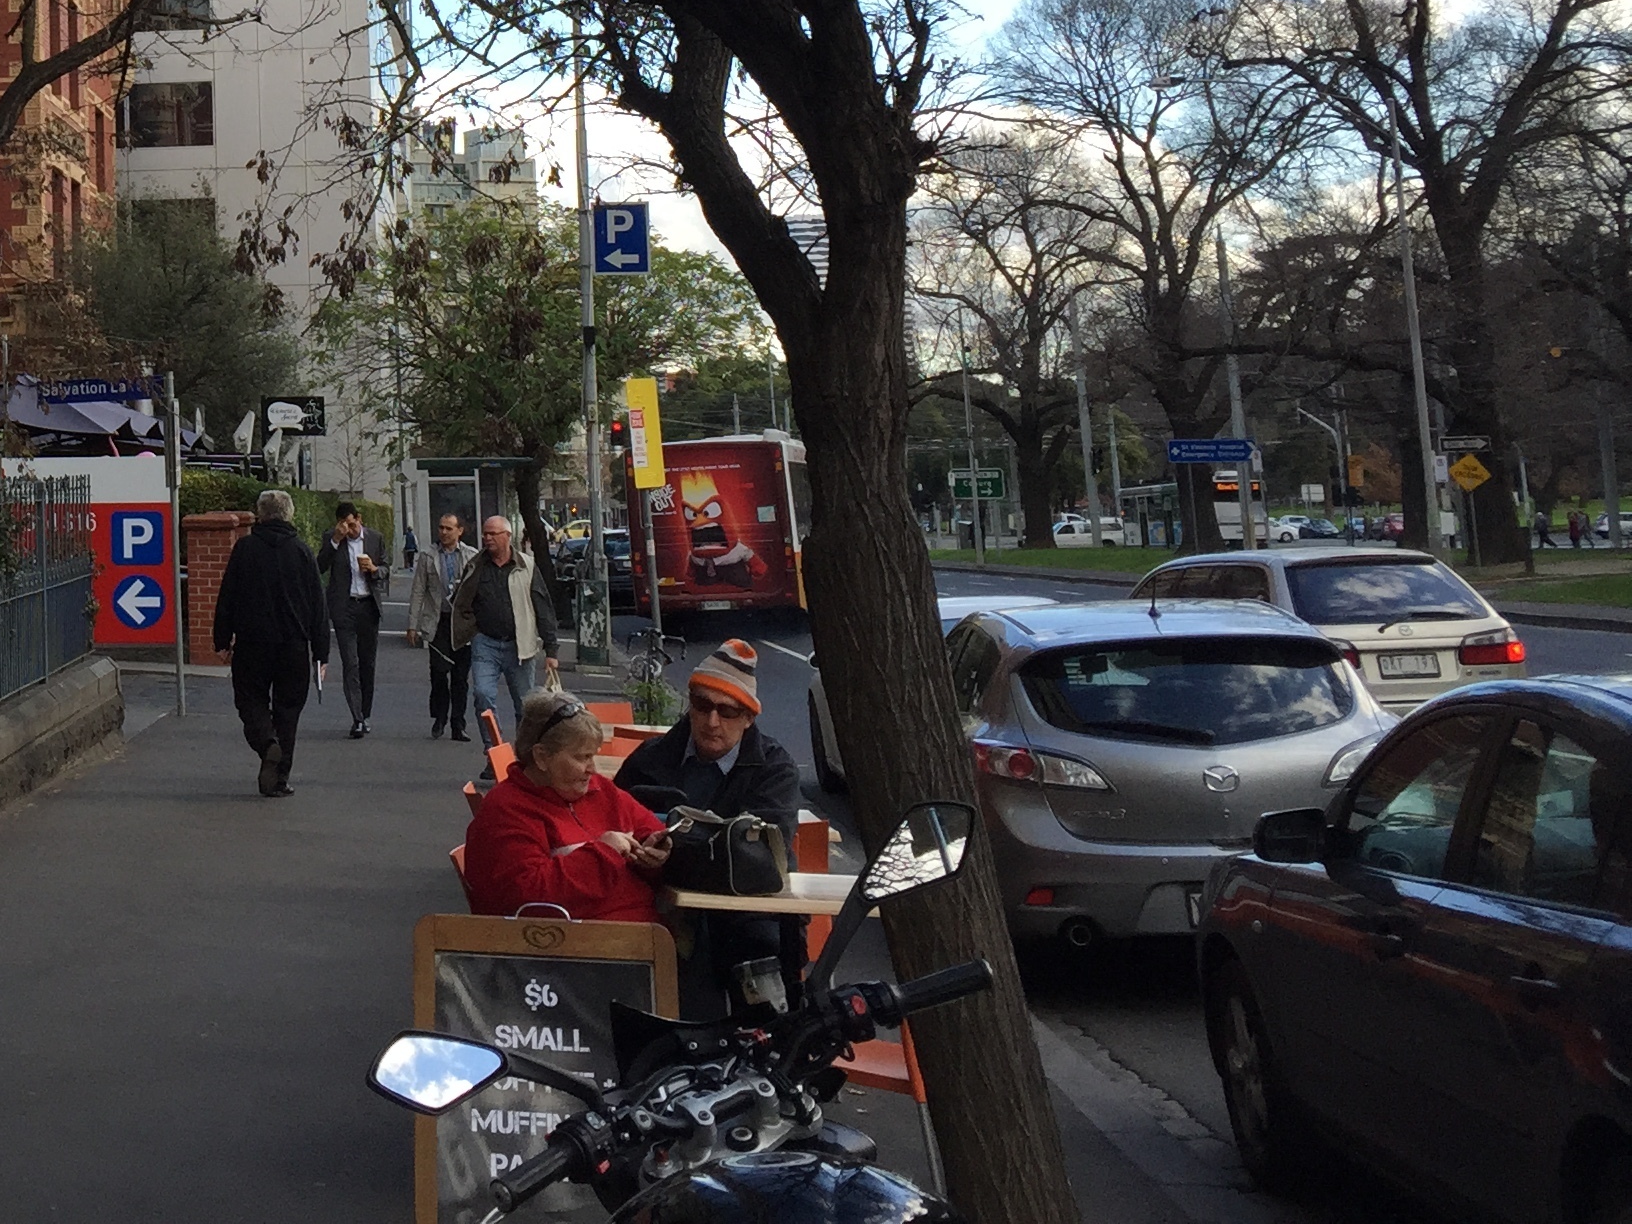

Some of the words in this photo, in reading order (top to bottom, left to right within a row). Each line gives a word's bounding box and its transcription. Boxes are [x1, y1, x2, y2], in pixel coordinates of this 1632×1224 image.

[606, 209, 634, 244] P
[42, 381, 107, 397] Salvation
[654, 494, 676, 512] OUT
[122, 517, 154, 559] P
[524, 978, 559, 1012] $6
[494, 1024, 591, 1053] SMALL
